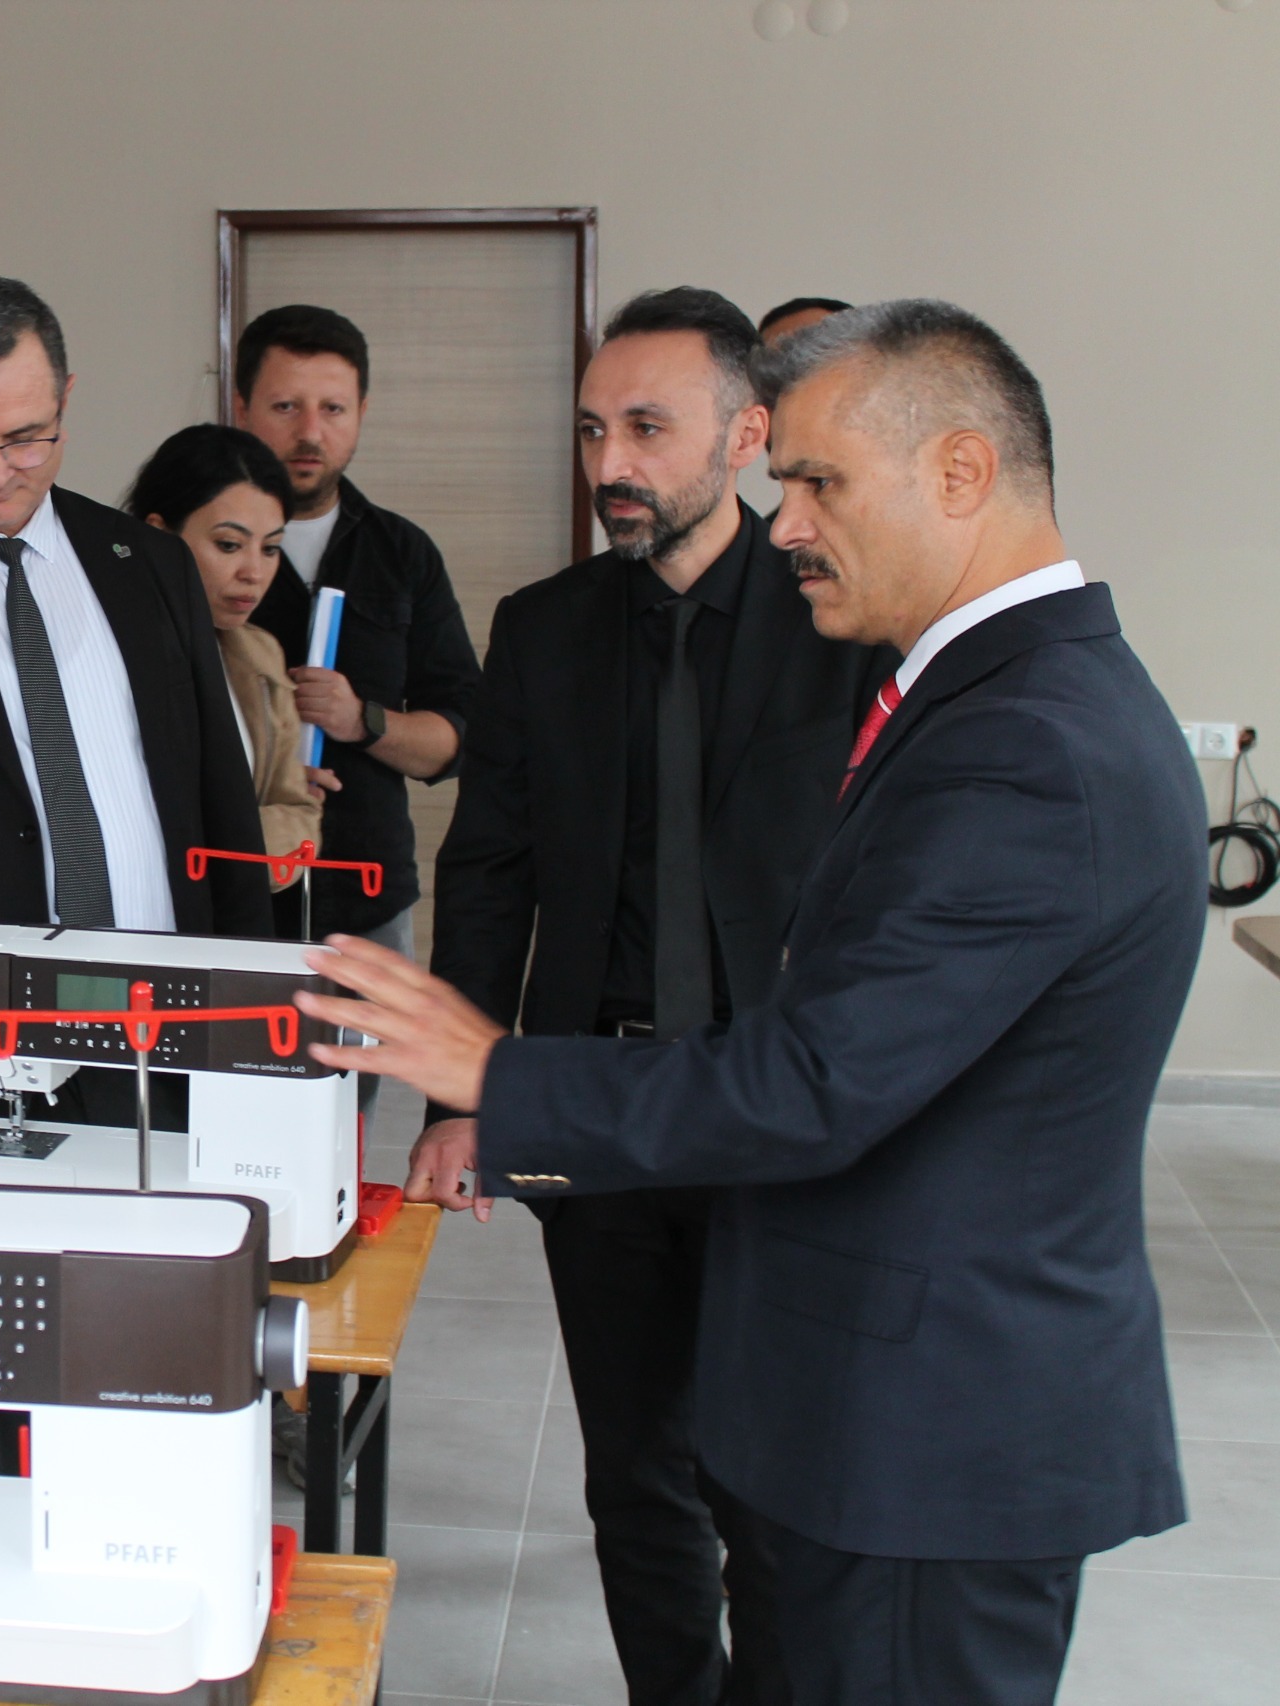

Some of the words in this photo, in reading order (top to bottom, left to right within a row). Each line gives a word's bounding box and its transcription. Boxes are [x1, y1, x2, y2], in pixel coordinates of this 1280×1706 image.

[232, 1062, 260, 1071] creative
[260, 1063, 290, 1073] ambition
[290, 1065, 307, 1074] 640
[234, 1162, 283, 1180] PFAFF
[15, 1275, 24, 1287] 2
[36, 1276, 46, 1287] 3
[36, 1320, 46, 1331] 9
[98, 1390, 140, 1402] creative
[141, 1391, 187, 1404] ambition
[188, 1394, 213, 1406] 640
[105, 1542, 178, 1565] PFAFF
